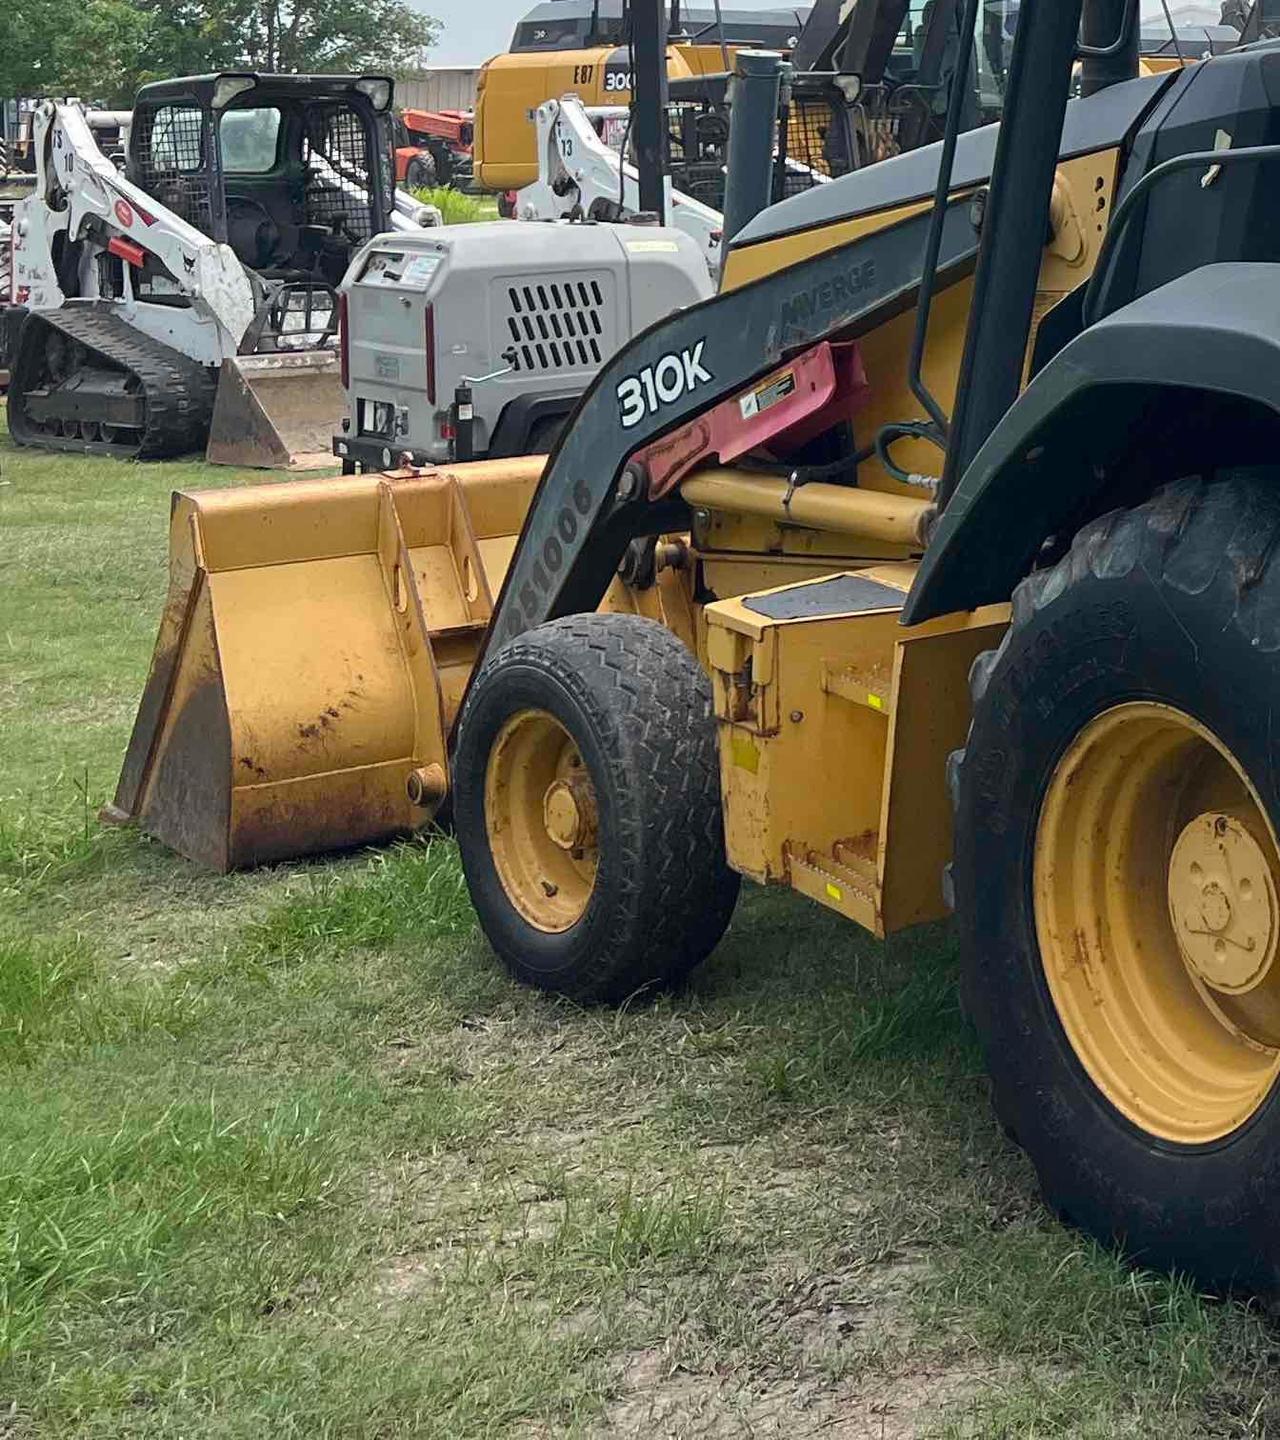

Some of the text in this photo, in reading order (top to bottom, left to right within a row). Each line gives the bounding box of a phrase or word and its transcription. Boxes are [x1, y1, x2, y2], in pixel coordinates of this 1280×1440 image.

[574, 65, 593, 84] E87
[64, 153, 74, 172] 10
[617, 341, 713, 427] 310K
